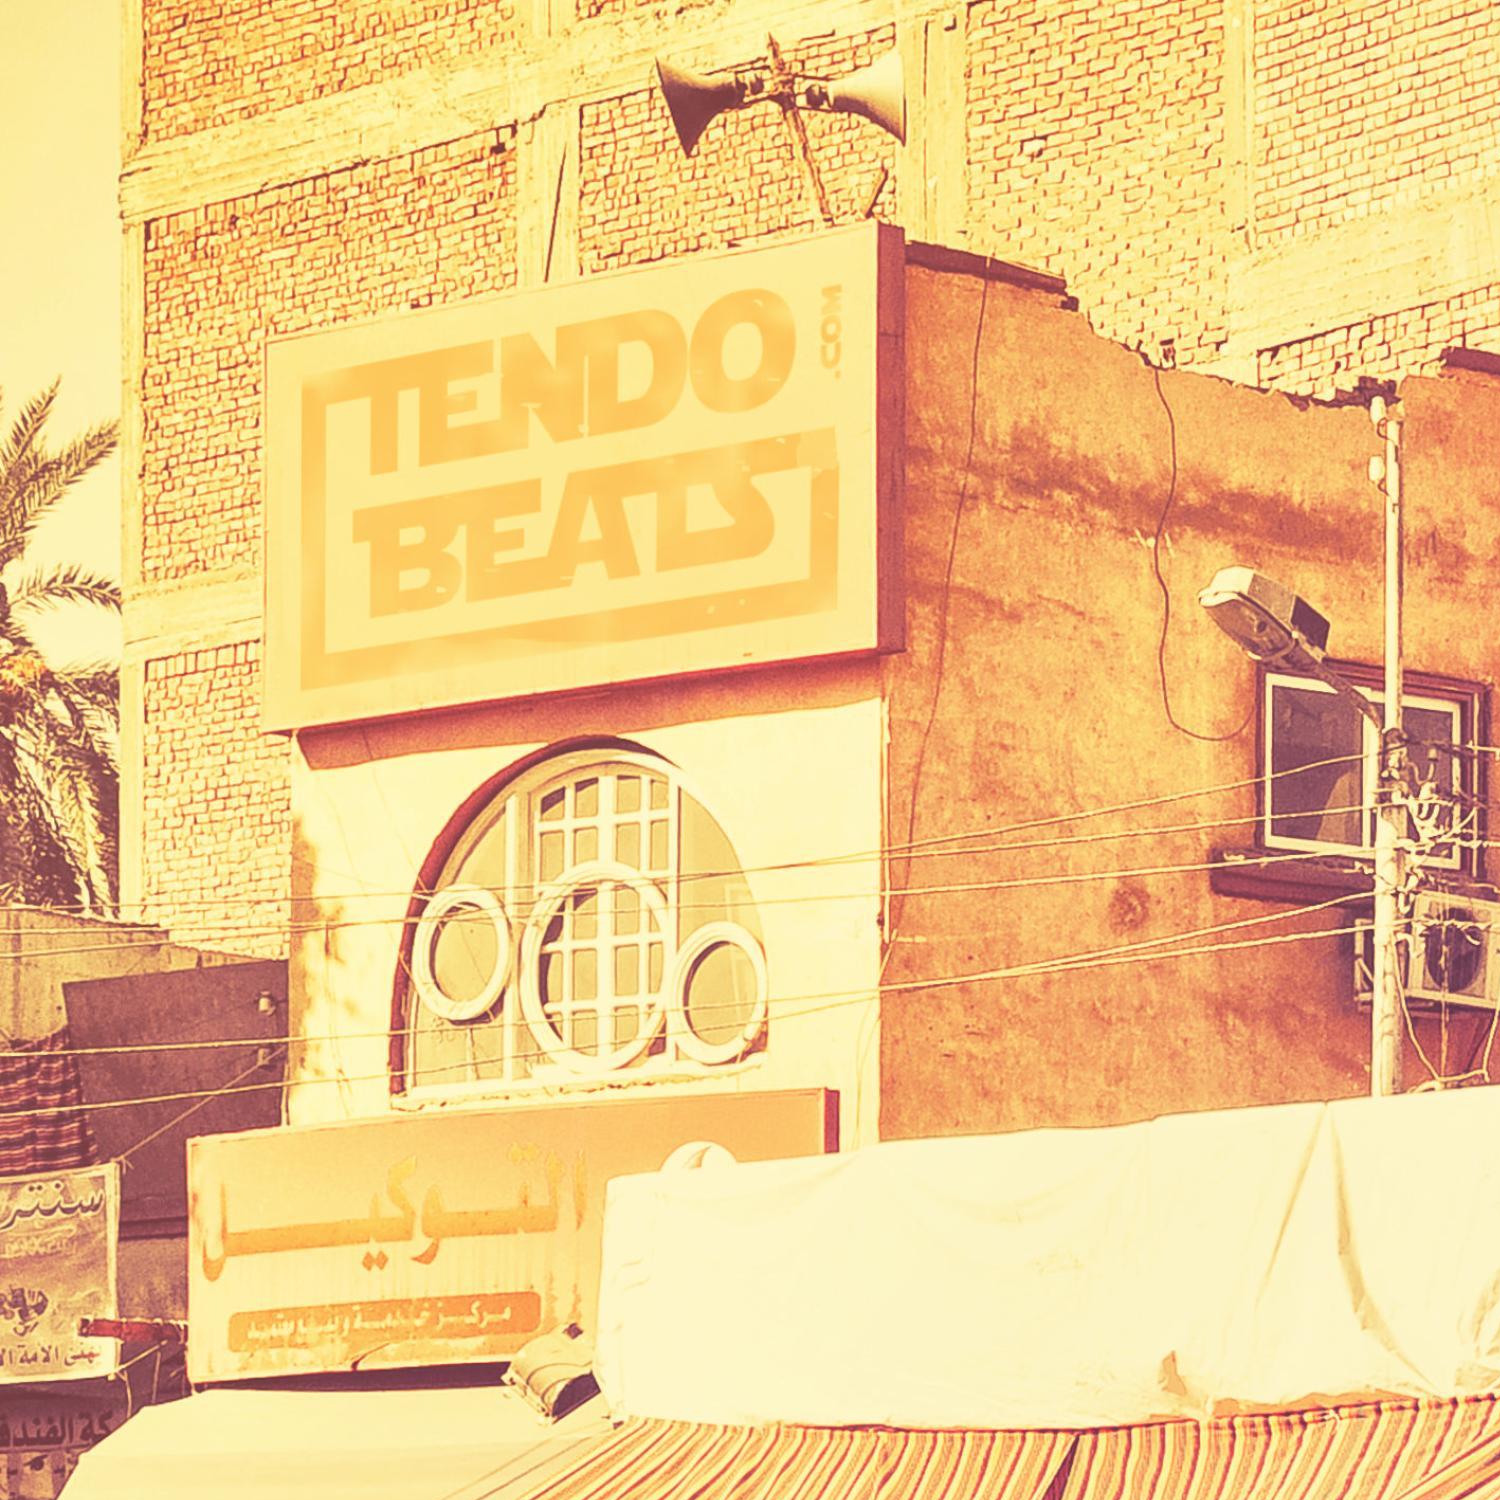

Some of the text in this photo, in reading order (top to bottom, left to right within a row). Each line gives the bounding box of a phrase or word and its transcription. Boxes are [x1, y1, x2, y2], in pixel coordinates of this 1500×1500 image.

[335, 287, 797, 477] TENDO
[820, 284, 842, 381] .COM
[352, 438, 800, 619] BEATS
[201, 1141, 588, 1282] التوكيل
[437, 1301, 512, 1330] مركز
